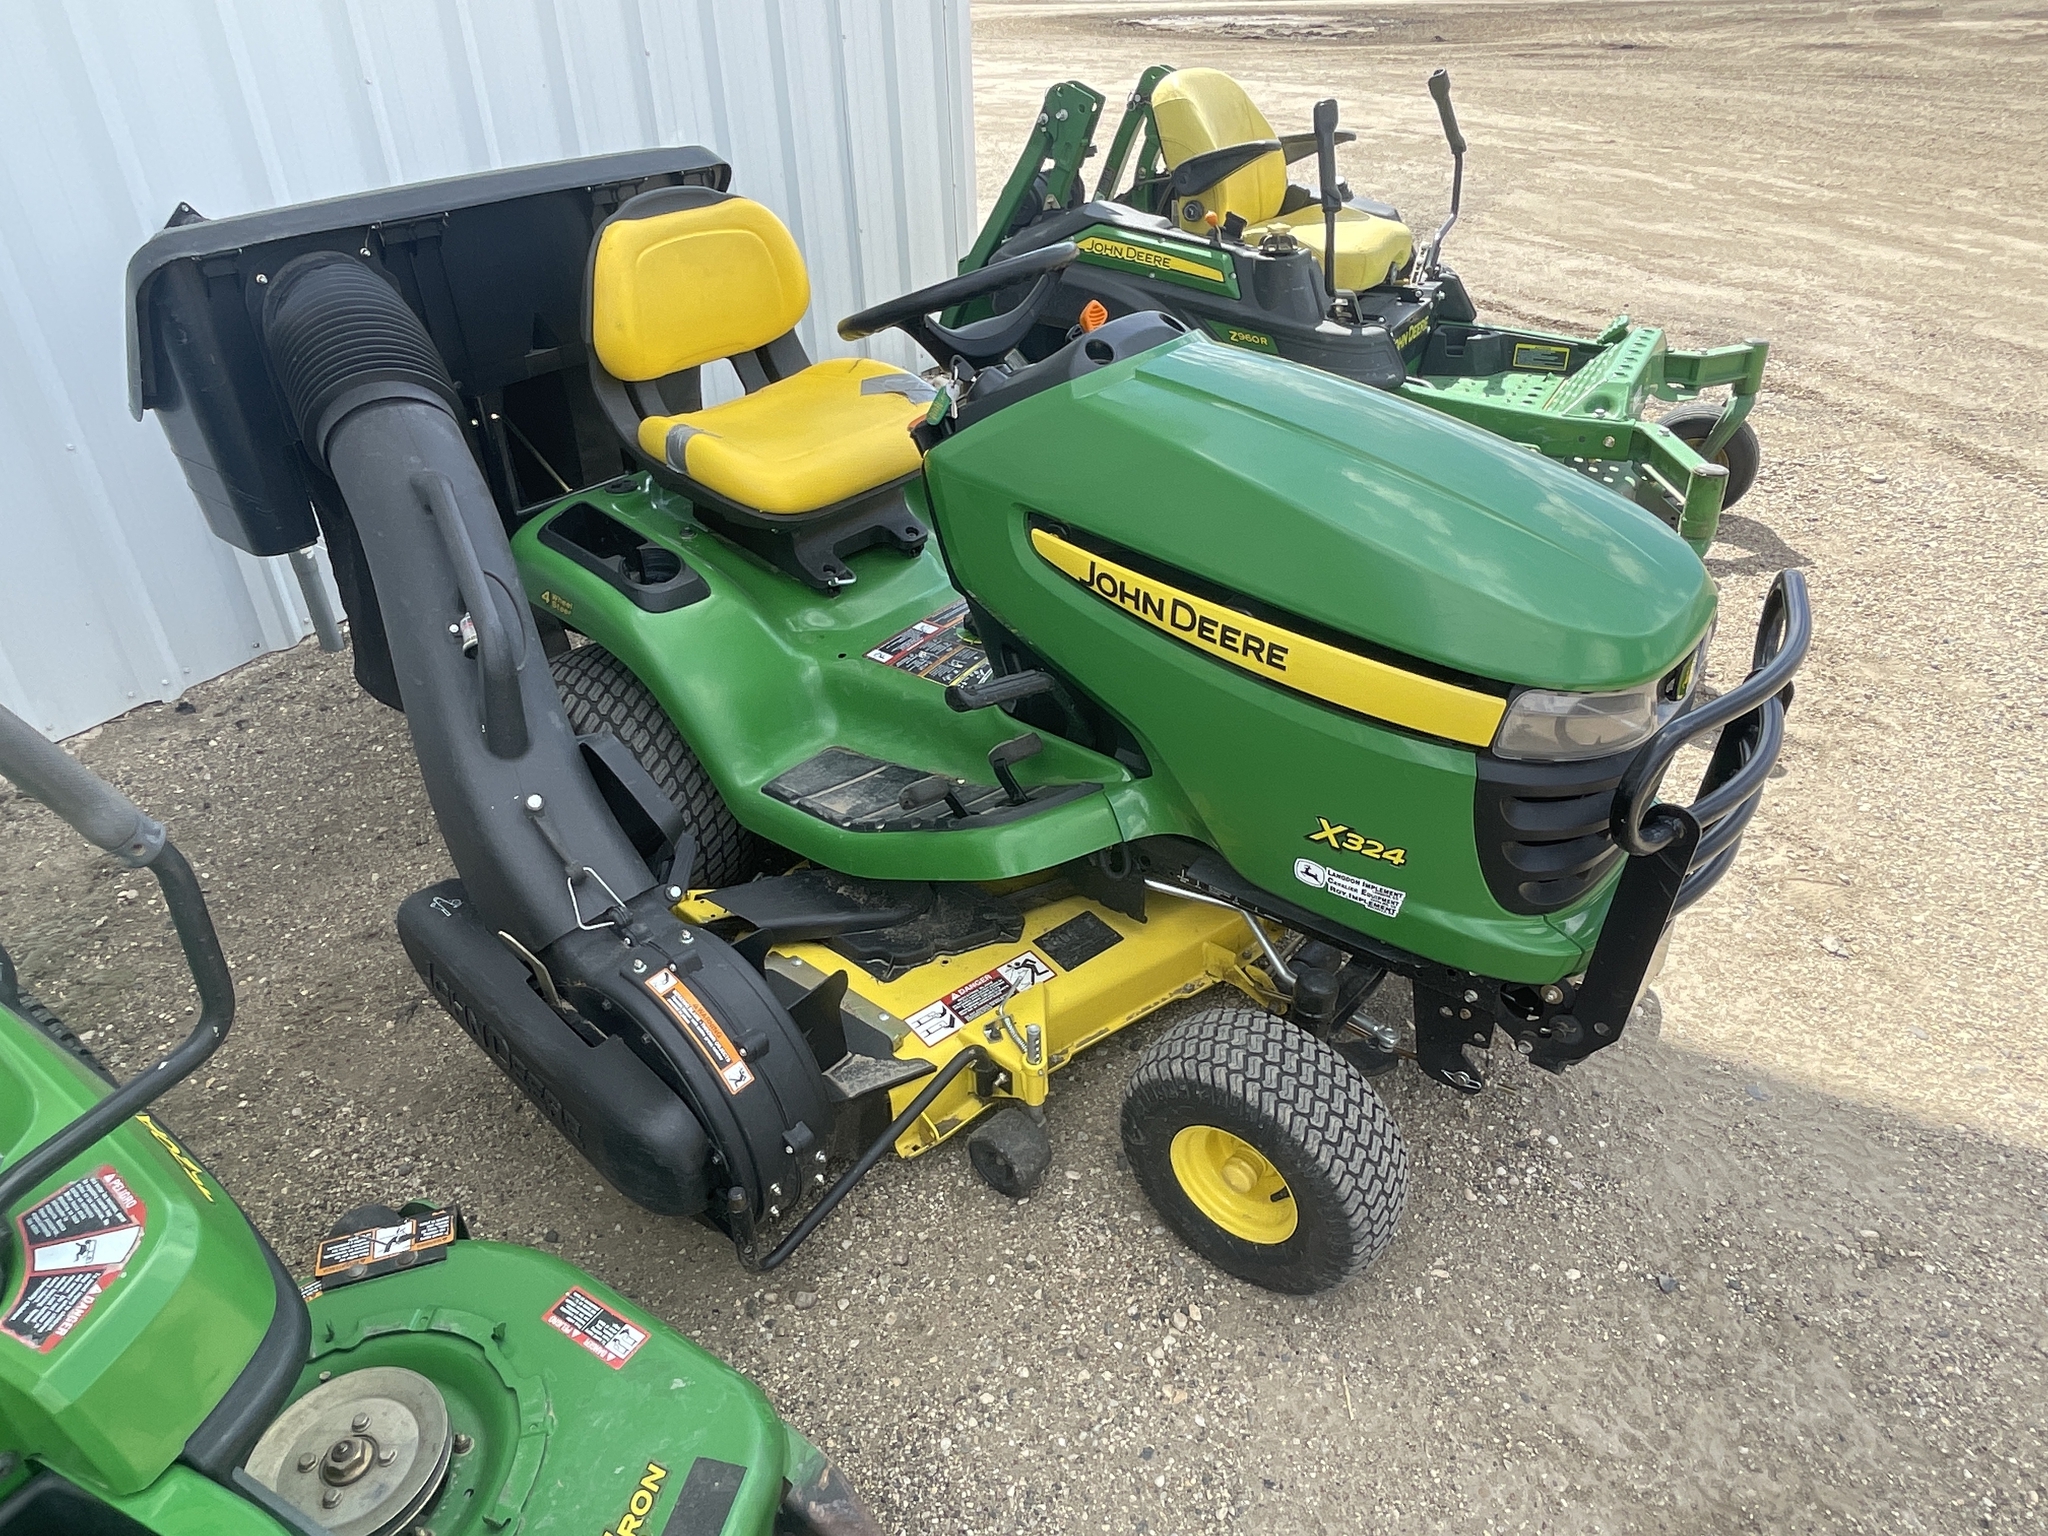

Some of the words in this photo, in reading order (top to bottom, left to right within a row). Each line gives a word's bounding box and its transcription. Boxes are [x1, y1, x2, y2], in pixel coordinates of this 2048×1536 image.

[1087, 239, 1123, 258] JOHN
[1126, 246, 1171, 268] DEERE
[1229, 330, 1268, 346] Z960R
[541, 590, 550, 604] 4
[1079, 561, 1164, 622] JOHN
[1170, 598, 1288, 671] DEERE
[1307, 816, 1406, 866] X324
[1362, 881, 1404, 899] IMPLEMENT
[957, 973, 992, 996] DANGER
[110, 1179, 138, 1209] PELIGRO
[55, 1294, 96, 1337] DANGER
[603, 1462, 668, 1536] RON
